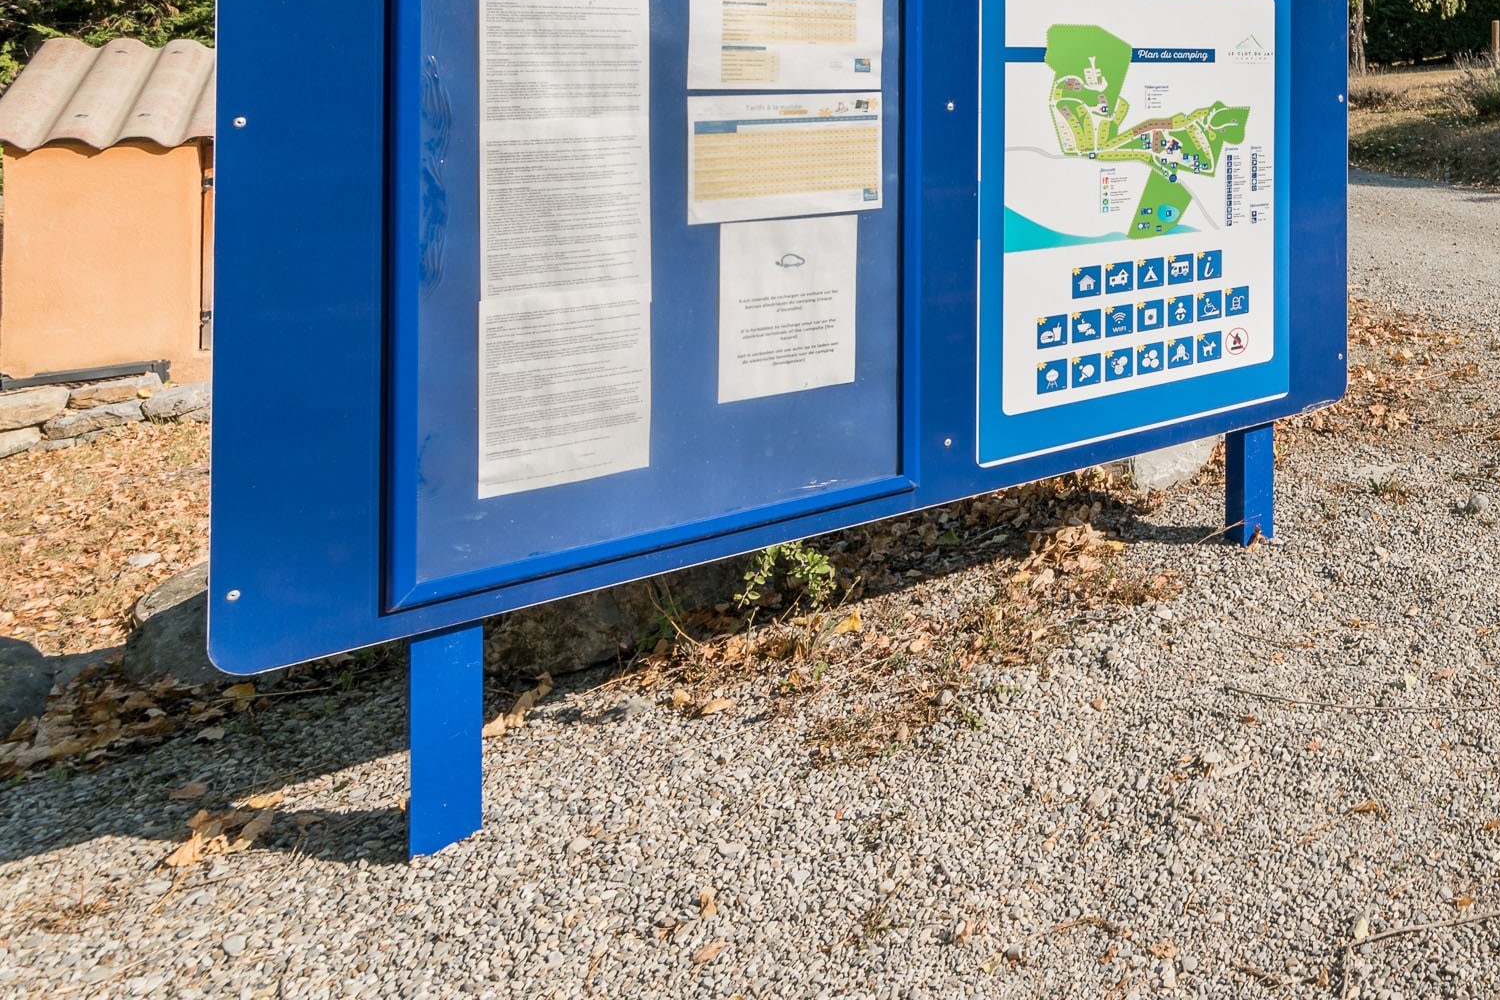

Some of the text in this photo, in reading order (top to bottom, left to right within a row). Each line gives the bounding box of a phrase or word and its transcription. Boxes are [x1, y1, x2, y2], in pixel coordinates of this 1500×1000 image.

[1137, 49, 1208, 61] Plan du camping
